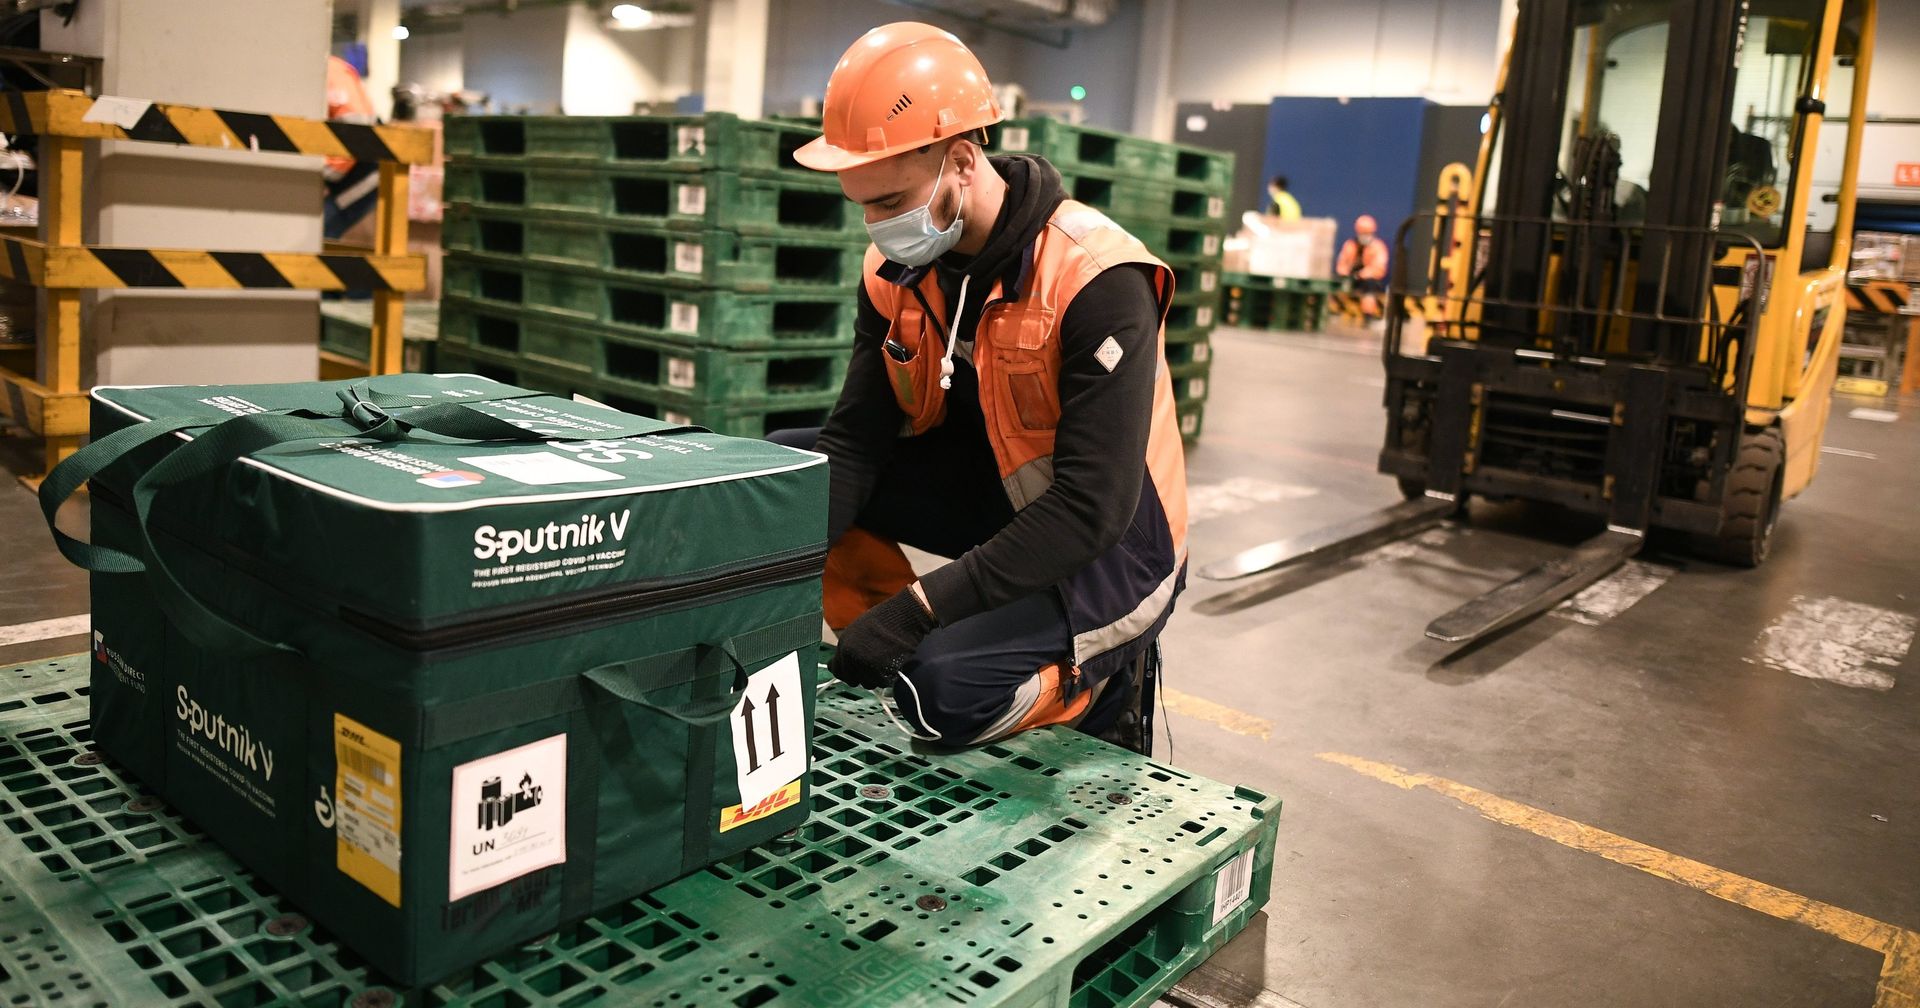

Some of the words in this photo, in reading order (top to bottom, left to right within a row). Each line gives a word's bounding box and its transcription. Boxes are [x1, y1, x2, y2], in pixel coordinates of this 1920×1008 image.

[473, 513, 605, 564] Sputnik
[609, 509, 631, 541] V
[473, 567, 491, 577] THE
[491, 564, 514, 576] FIRST
[515, 559, 561, 572] REGISTERED
[176, 684, 257, 771] Sputnik
[258, 740, 273, 781] V
[731, 788, 790, 824] DHL
[472, 839, 495, 856] UN
